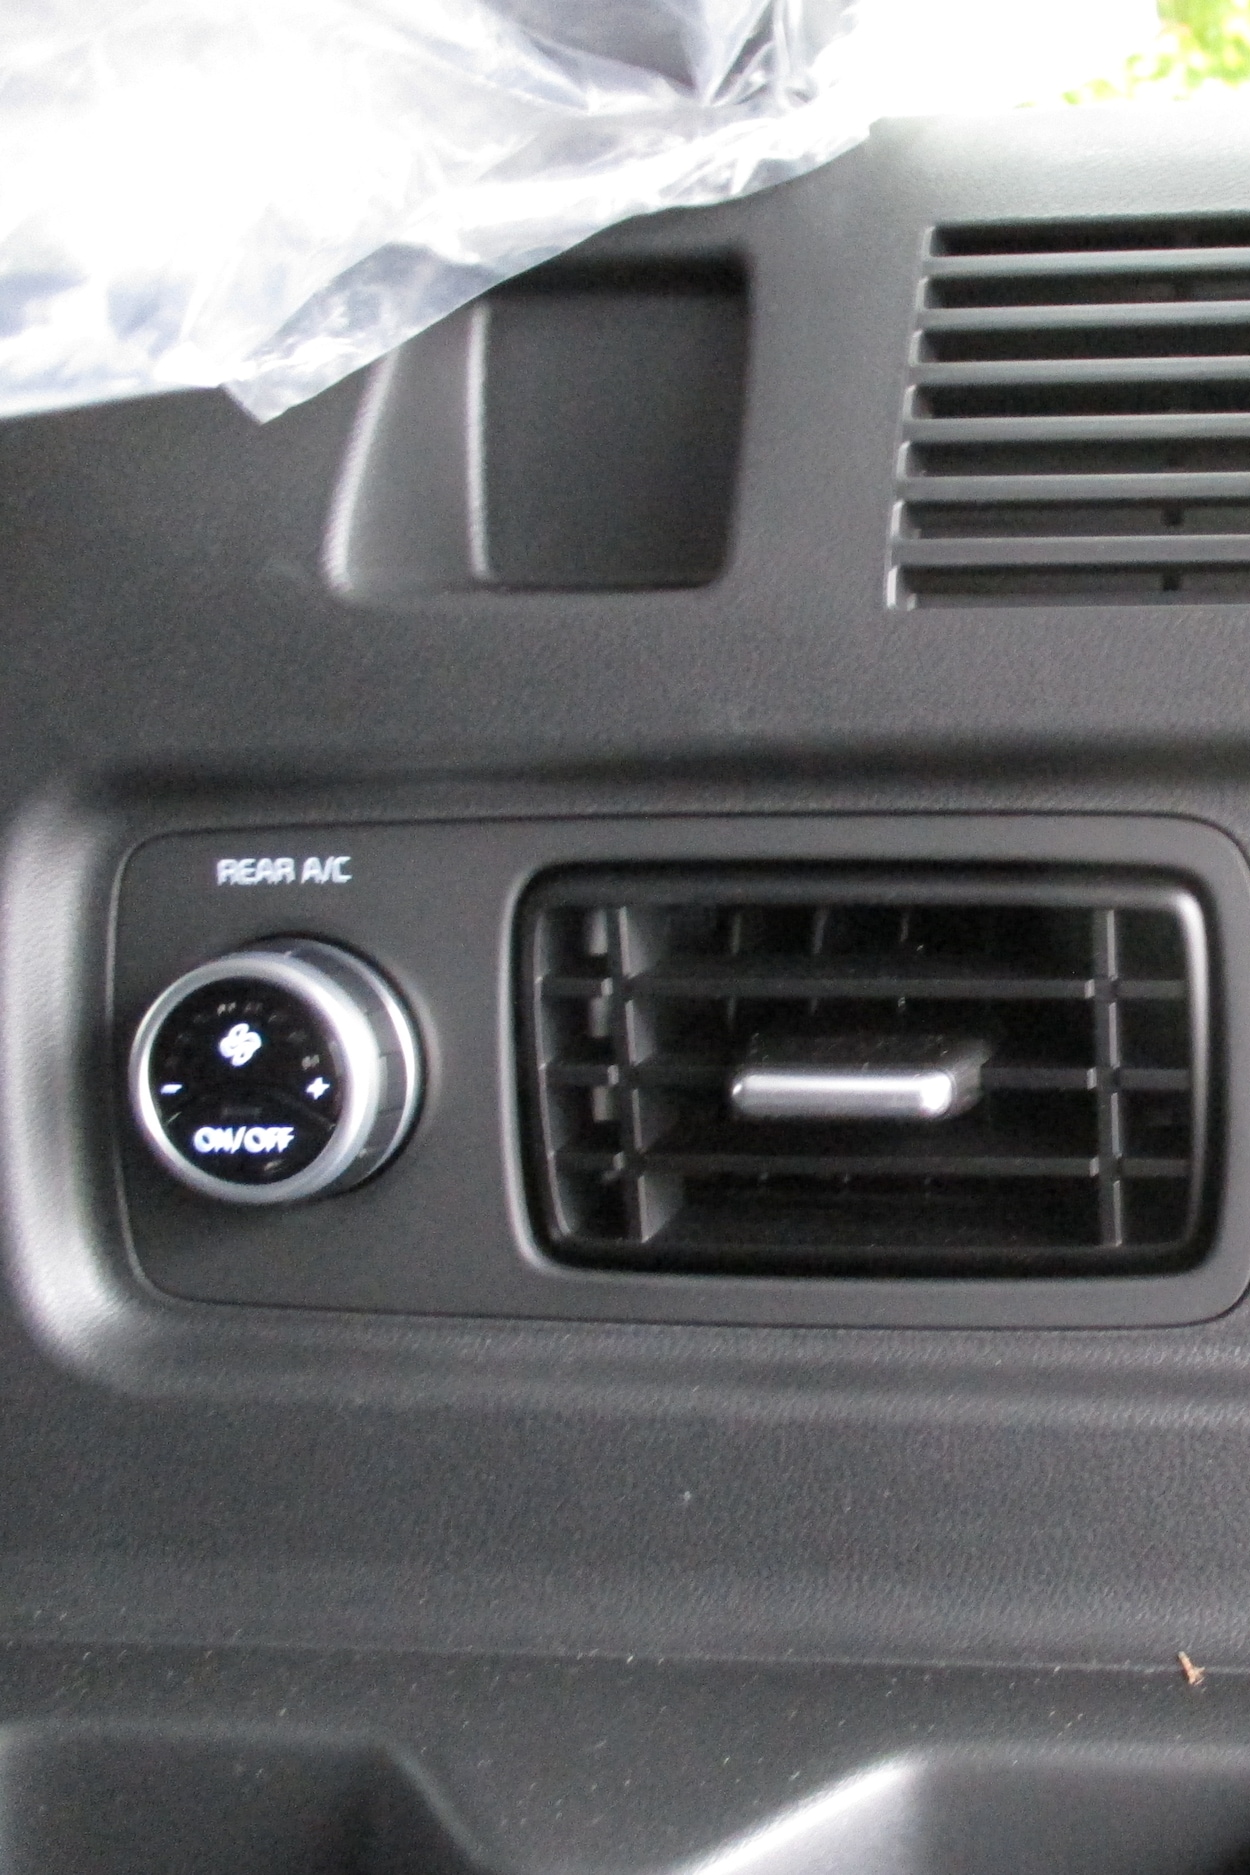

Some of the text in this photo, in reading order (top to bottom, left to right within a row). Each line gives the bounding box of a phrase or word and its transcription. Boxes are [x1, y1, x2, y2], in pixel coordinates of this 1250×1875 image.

[217, 856, 352, 885] REAR A/C
[194, 1126, 294, 1154] ON/OFF
